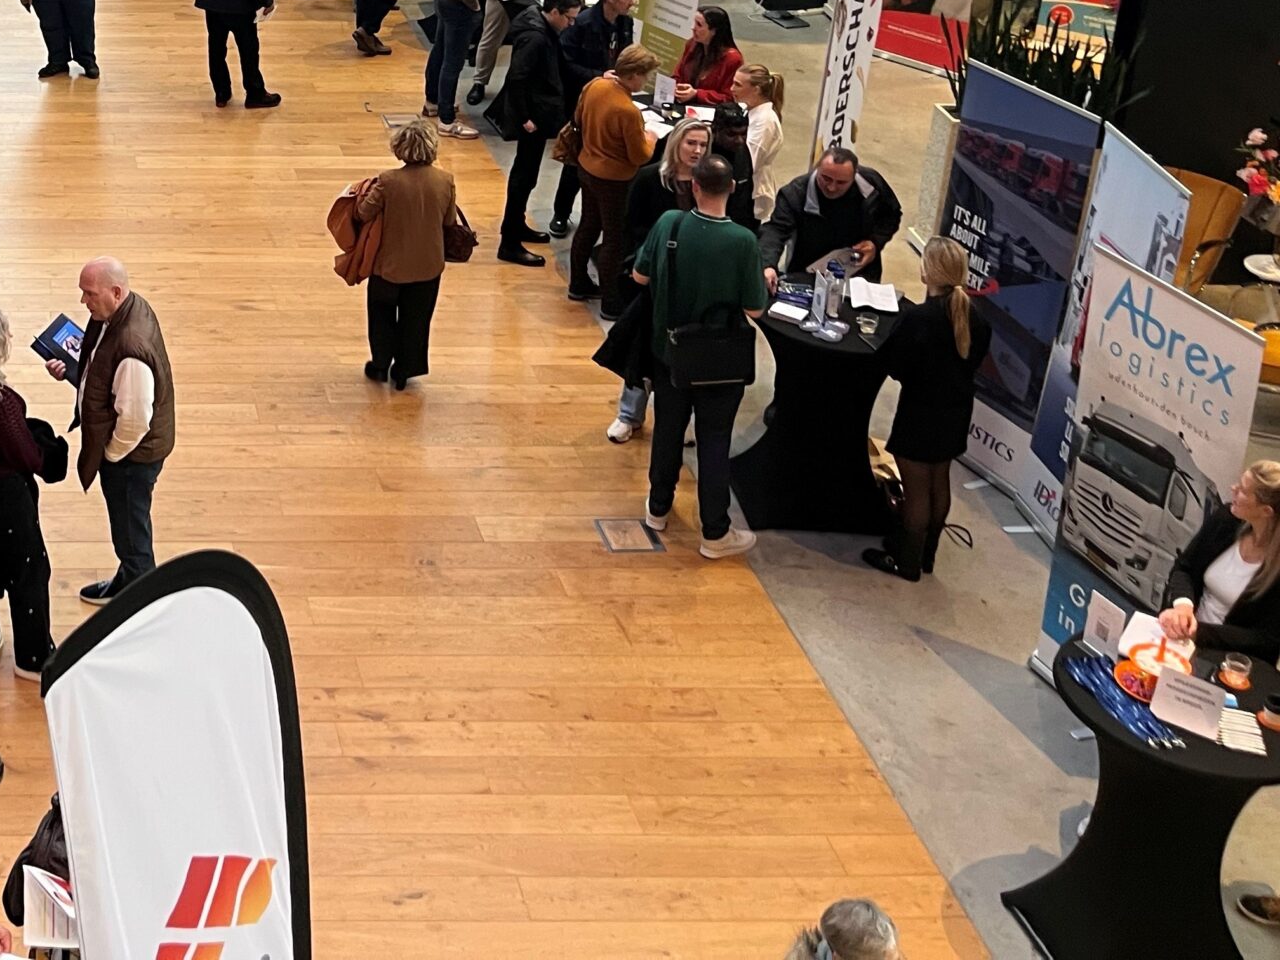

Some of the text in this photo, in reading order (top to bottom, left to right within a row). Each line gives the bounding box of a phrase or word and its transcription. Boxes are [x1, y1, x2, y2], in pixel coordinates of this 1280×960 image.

[949, 223, 980, 250] ABOUT
[953, 204, 987, 236] IT'S ALL
[1104, 277, 1237, 398] Abrex
[1098, 321, 1230, 426] logistics
[969, 422, 1015, 463] ISTICS
